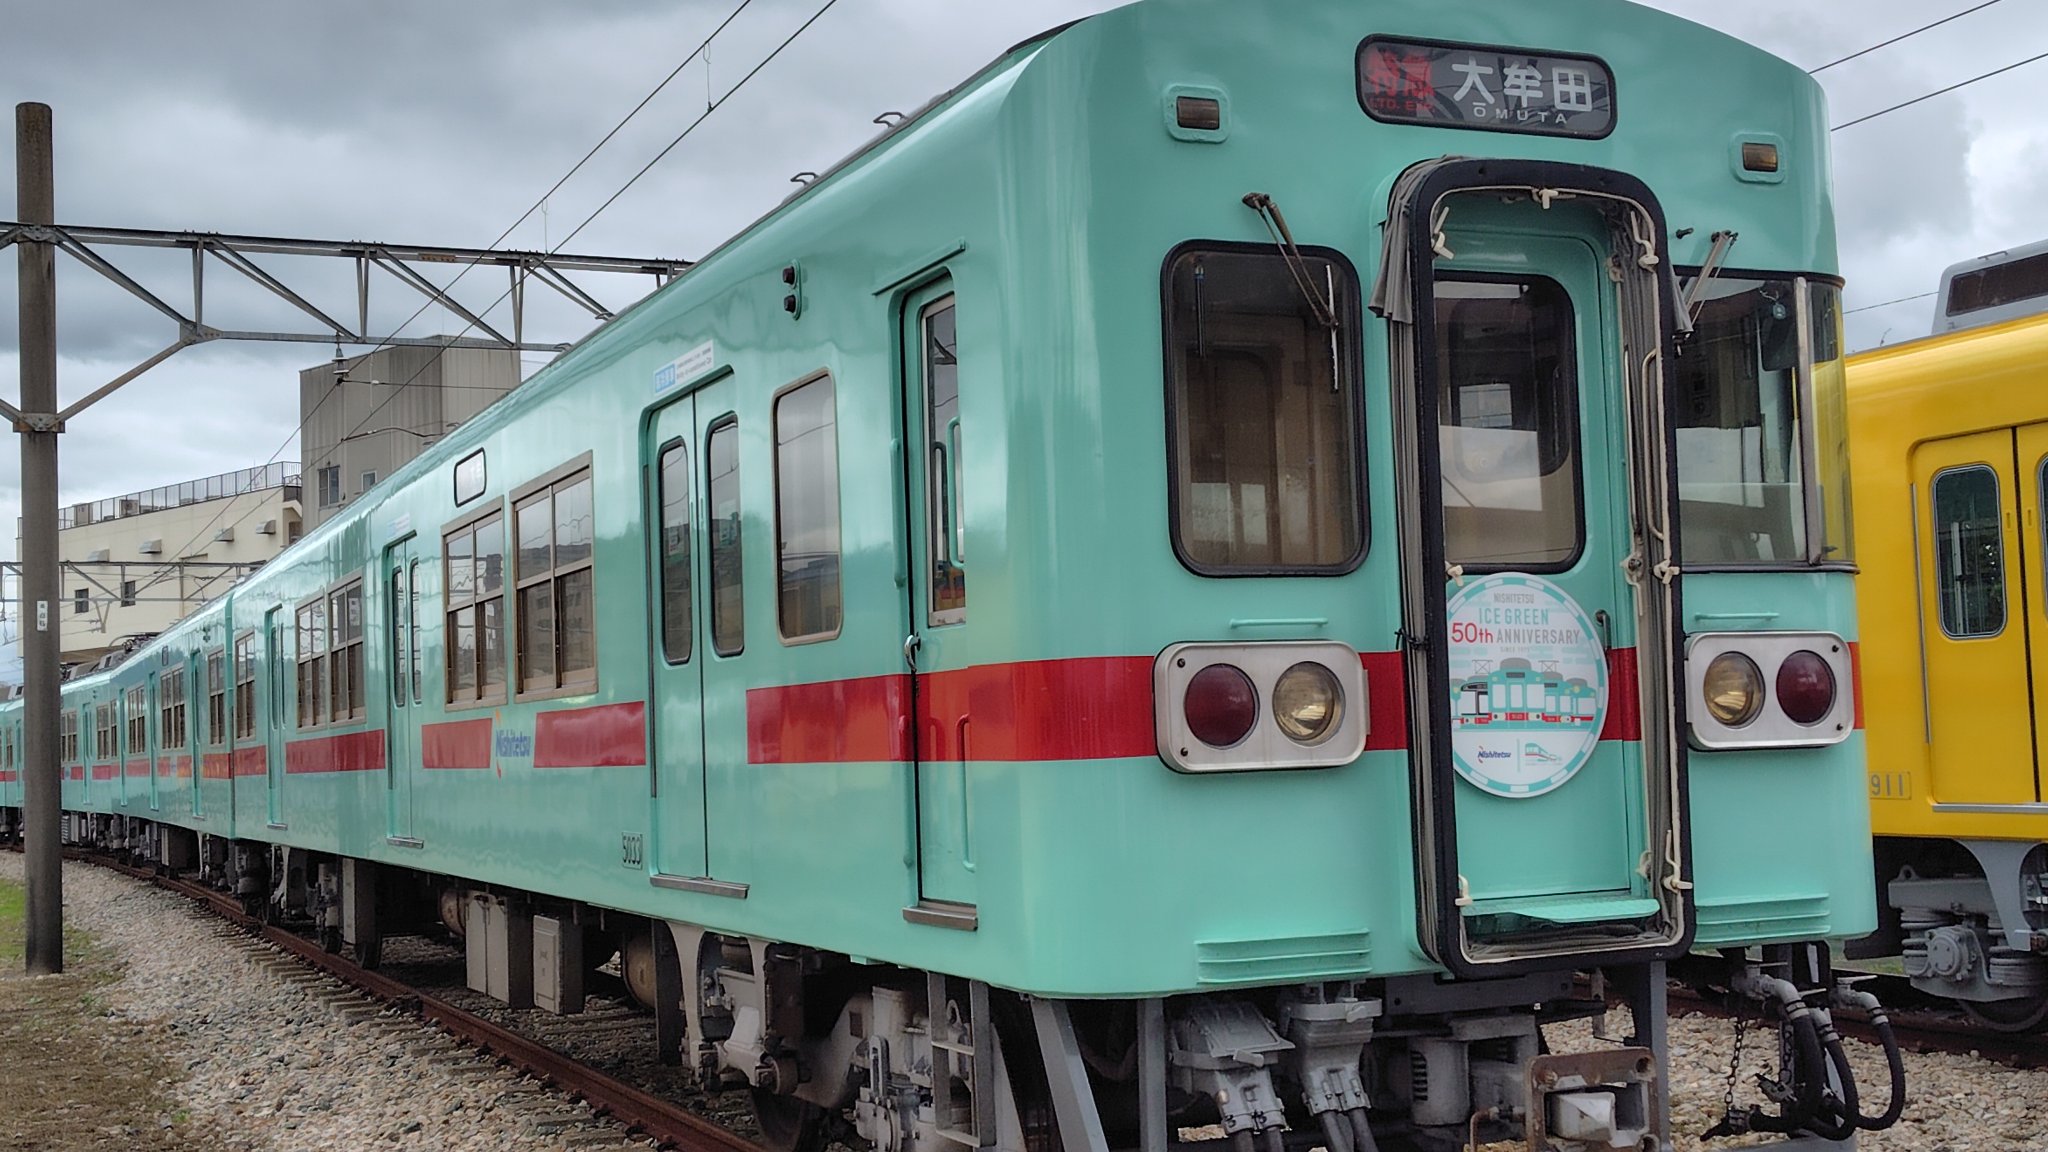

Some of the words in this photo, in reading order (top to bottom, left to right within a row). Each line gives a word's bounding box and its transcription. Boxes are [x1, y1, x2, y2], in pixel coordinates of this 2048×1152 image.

[1451, 56, 1592, 112] 大牟田
[1493, 592, 1535, 605] NISHITETSU
[1478, 607, 1501, 624] ICE
[1504, 608, 1549, 626] GREEN
[1451, 622, 1494, 644] 50th
[1496, 629, 1581, 645] ANNIVERSARY
[495, 728, 531, 758] Nishitetsu
[1477, 749, 1511, 761] Nishitetsu
[1871, 773, 1904, 797] 911
[623, 835, 641, 865] 5033
